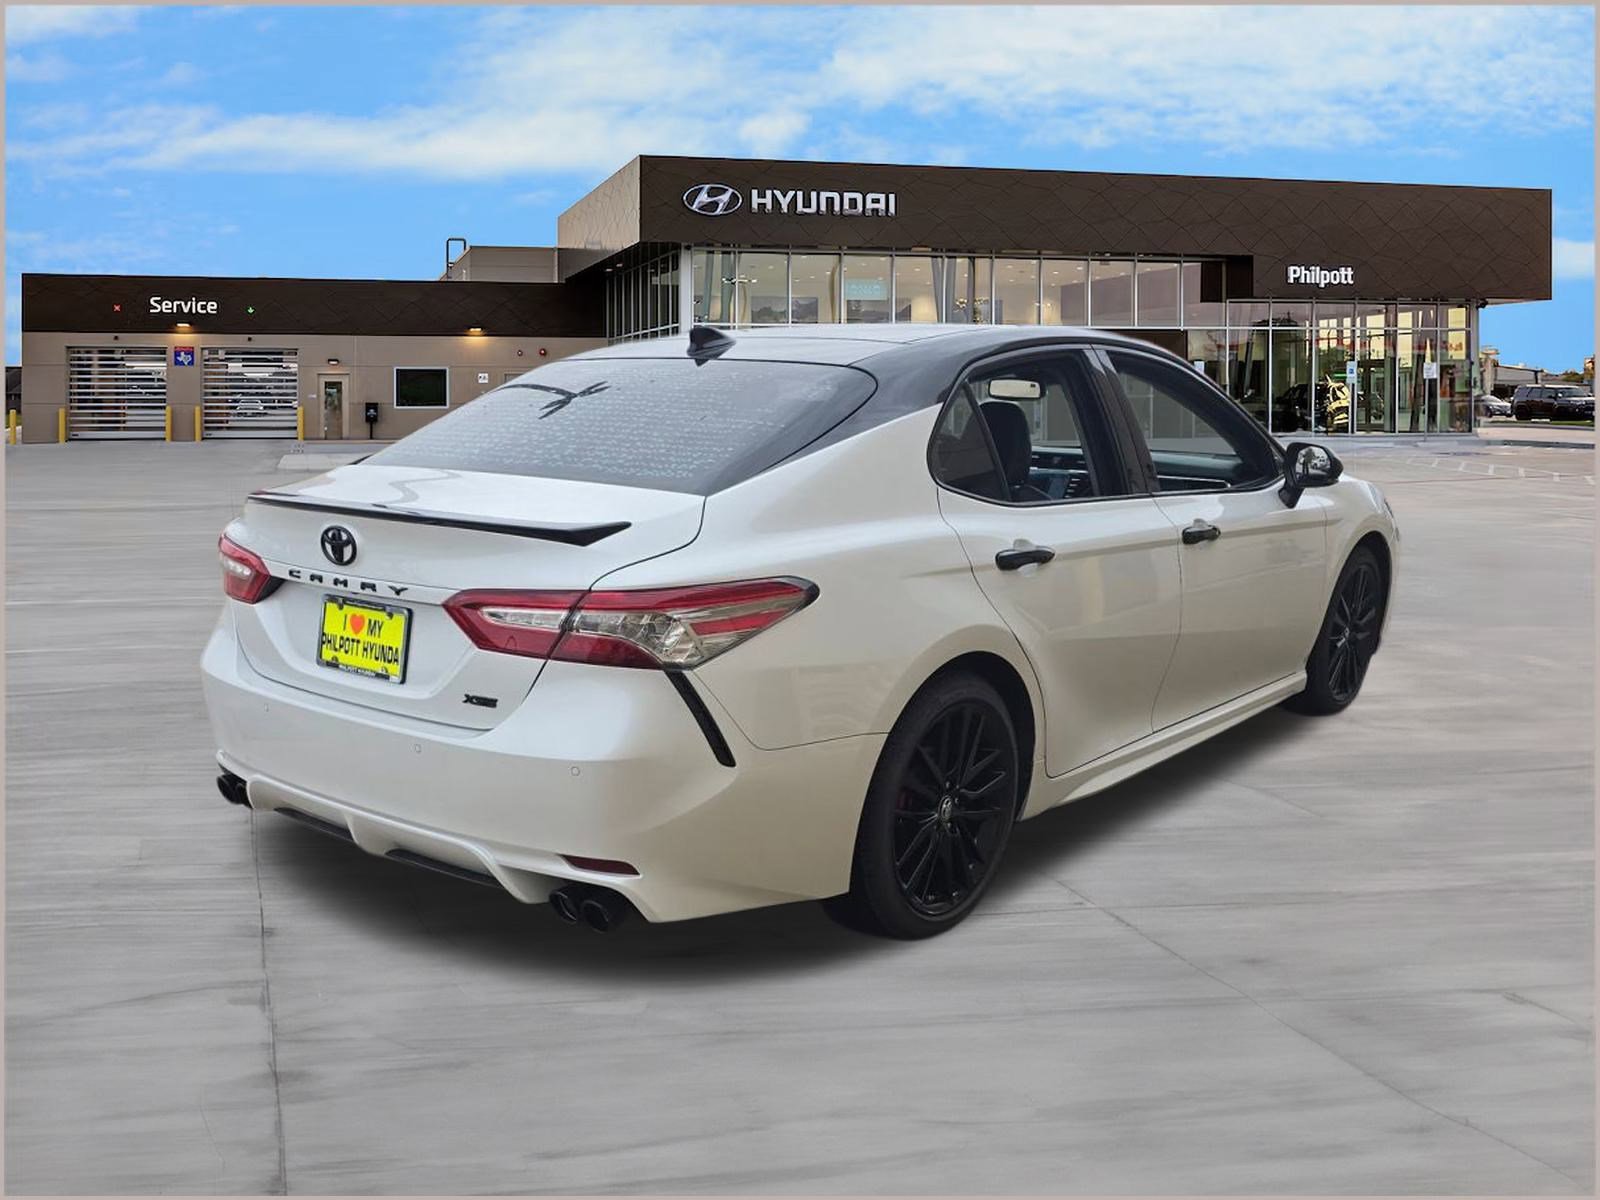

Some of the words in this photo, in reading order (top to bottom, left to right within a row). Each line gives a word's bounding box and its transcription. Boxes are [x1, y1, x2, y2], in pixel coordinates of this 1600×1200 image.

[751, 189, 895, 216] HYUNDAI
[1287, 265, 1354, 287] Philpott
[149, 296, 218, 314] Service
[289, 569, 408, 595] CAMRY
[367, 619, 384, 638] MY
[322, 632, 360, 656] PHILPOTT
